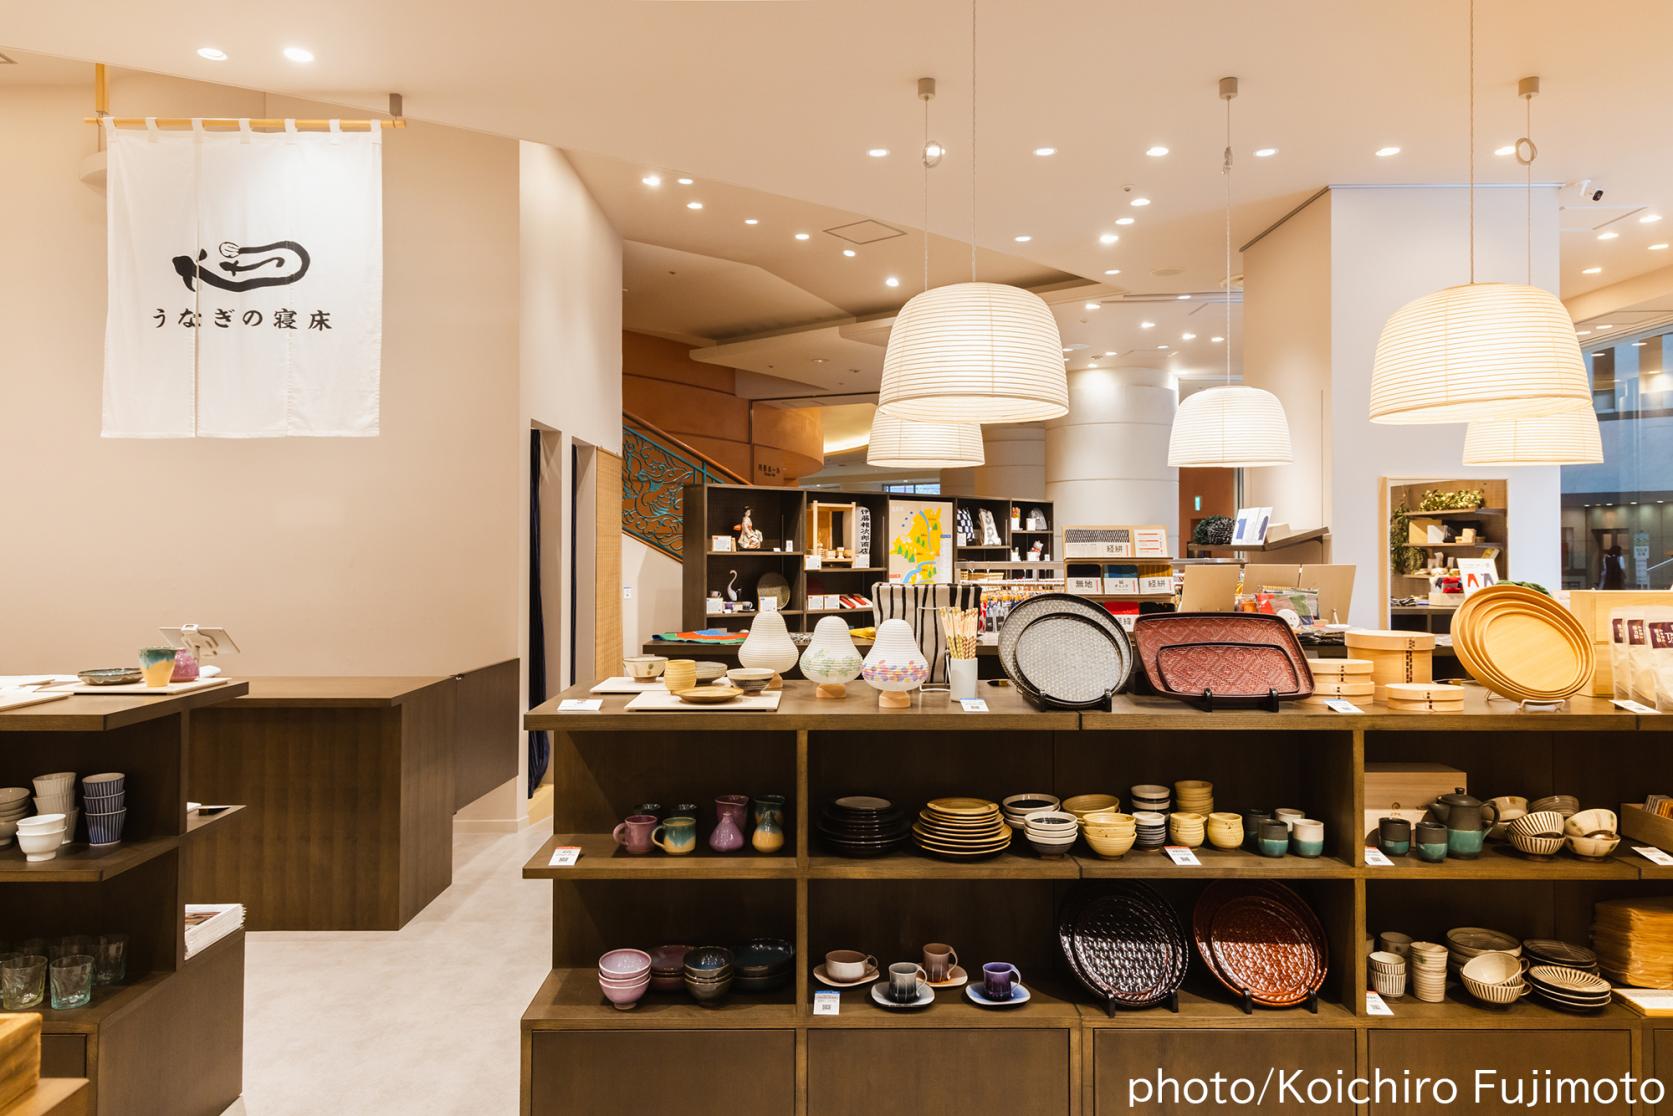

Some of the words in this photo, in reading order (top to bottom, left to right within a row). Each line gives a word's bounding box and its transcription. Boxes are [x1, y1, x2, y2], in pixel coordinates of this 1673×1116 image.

[153, 308, 332, 331] うなぎの寝床
